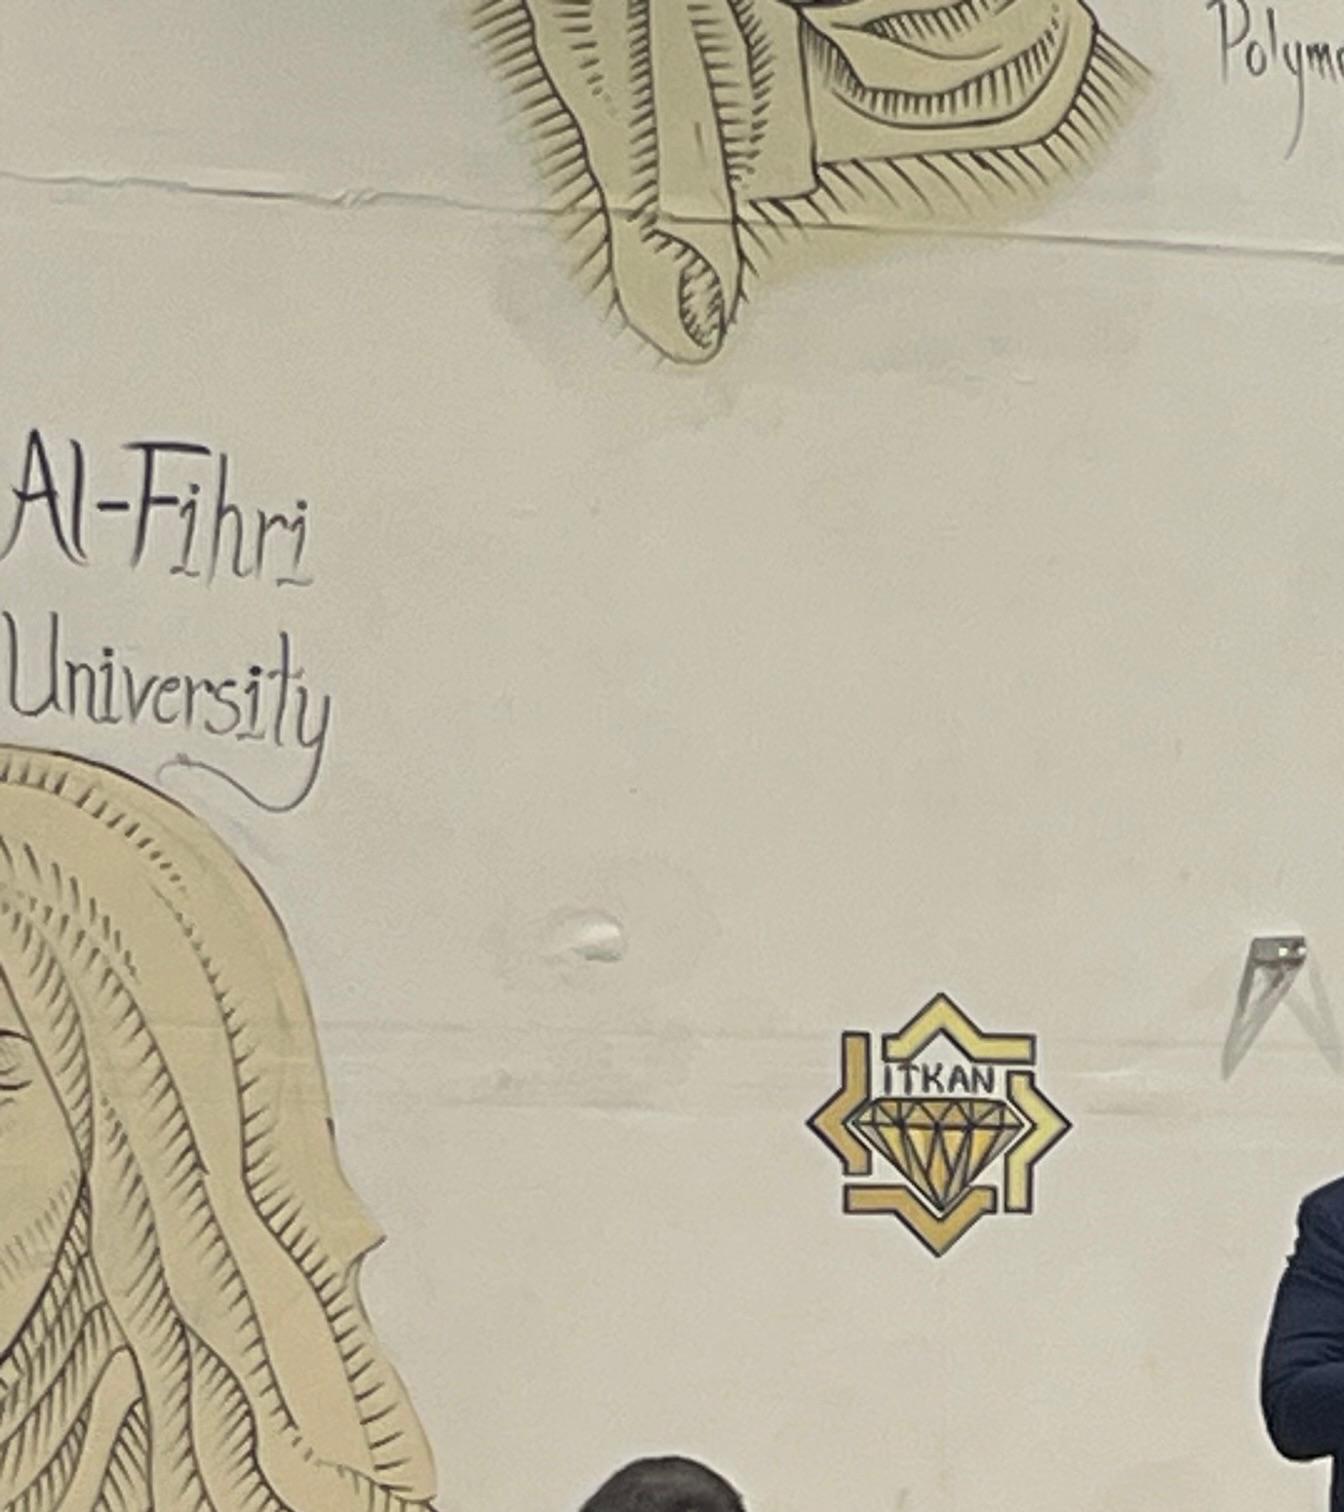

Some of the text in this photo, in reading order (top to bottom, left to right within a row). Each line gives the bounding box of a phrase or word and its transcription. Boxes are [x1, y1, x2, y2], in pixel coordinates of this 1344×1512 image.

[0, 428, 314, 588] Al-Fihri
[1, 610, 331, 813] University
[882, 1061, 996, 1096] ITKAN
